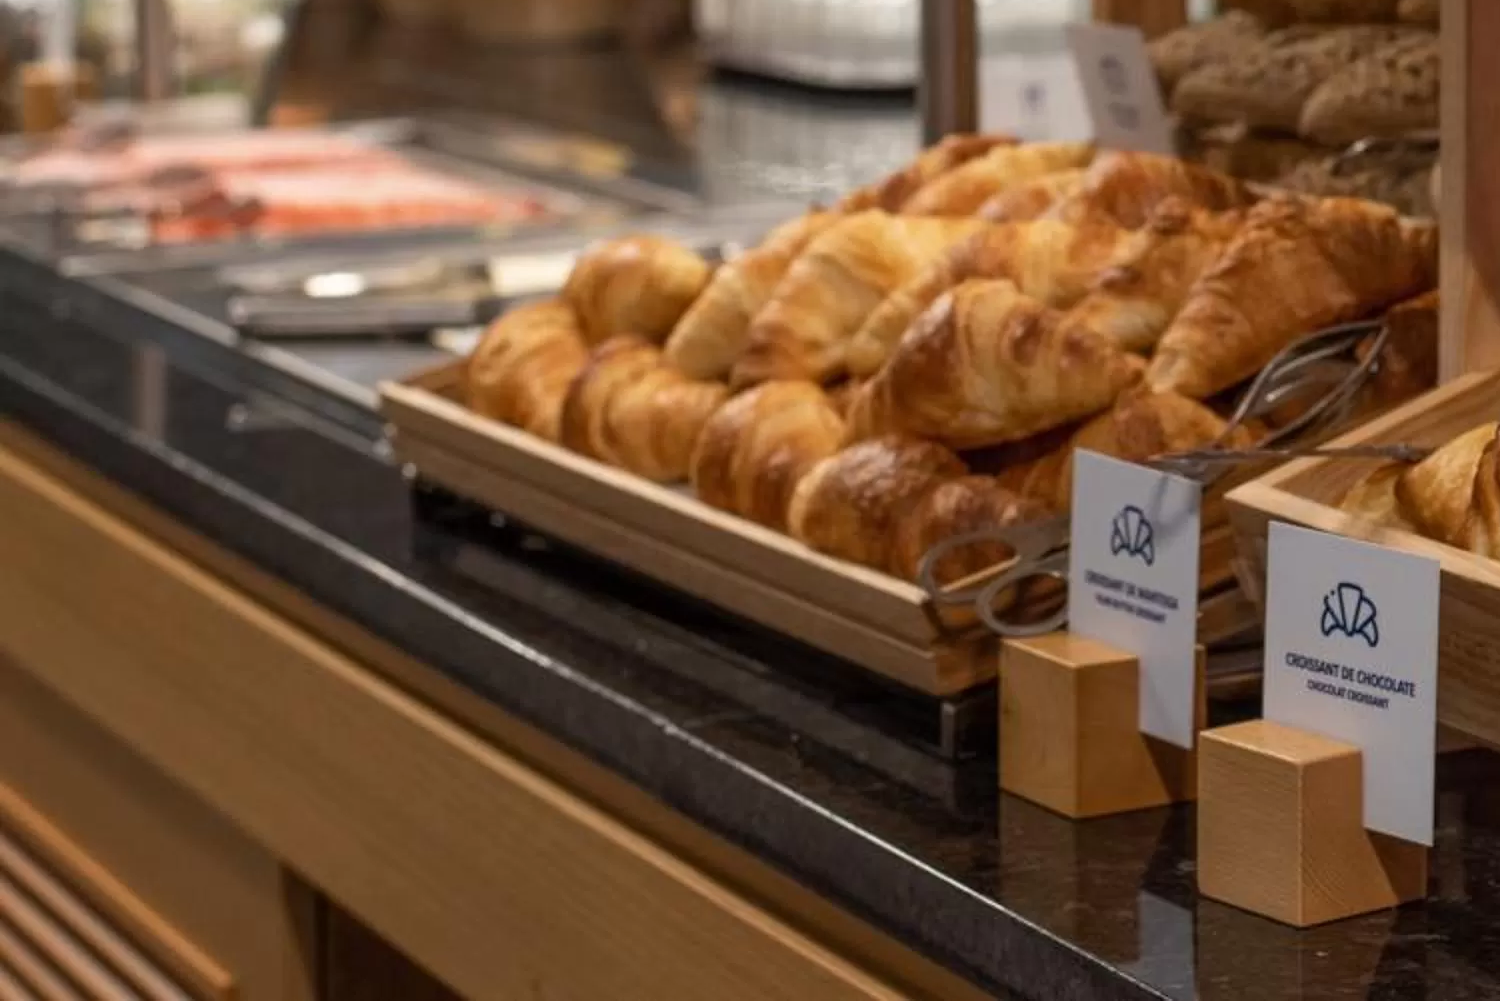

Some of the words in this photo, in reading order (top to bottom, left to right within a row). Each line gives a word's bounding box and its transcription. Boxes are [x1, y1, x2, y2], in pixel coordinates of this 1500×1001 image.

[1285, 652, 1340, 677] CROISSANT
[1341, 666, 1355, 681] DE
[1356, 670, 1416, 697] CHOCOLATE
